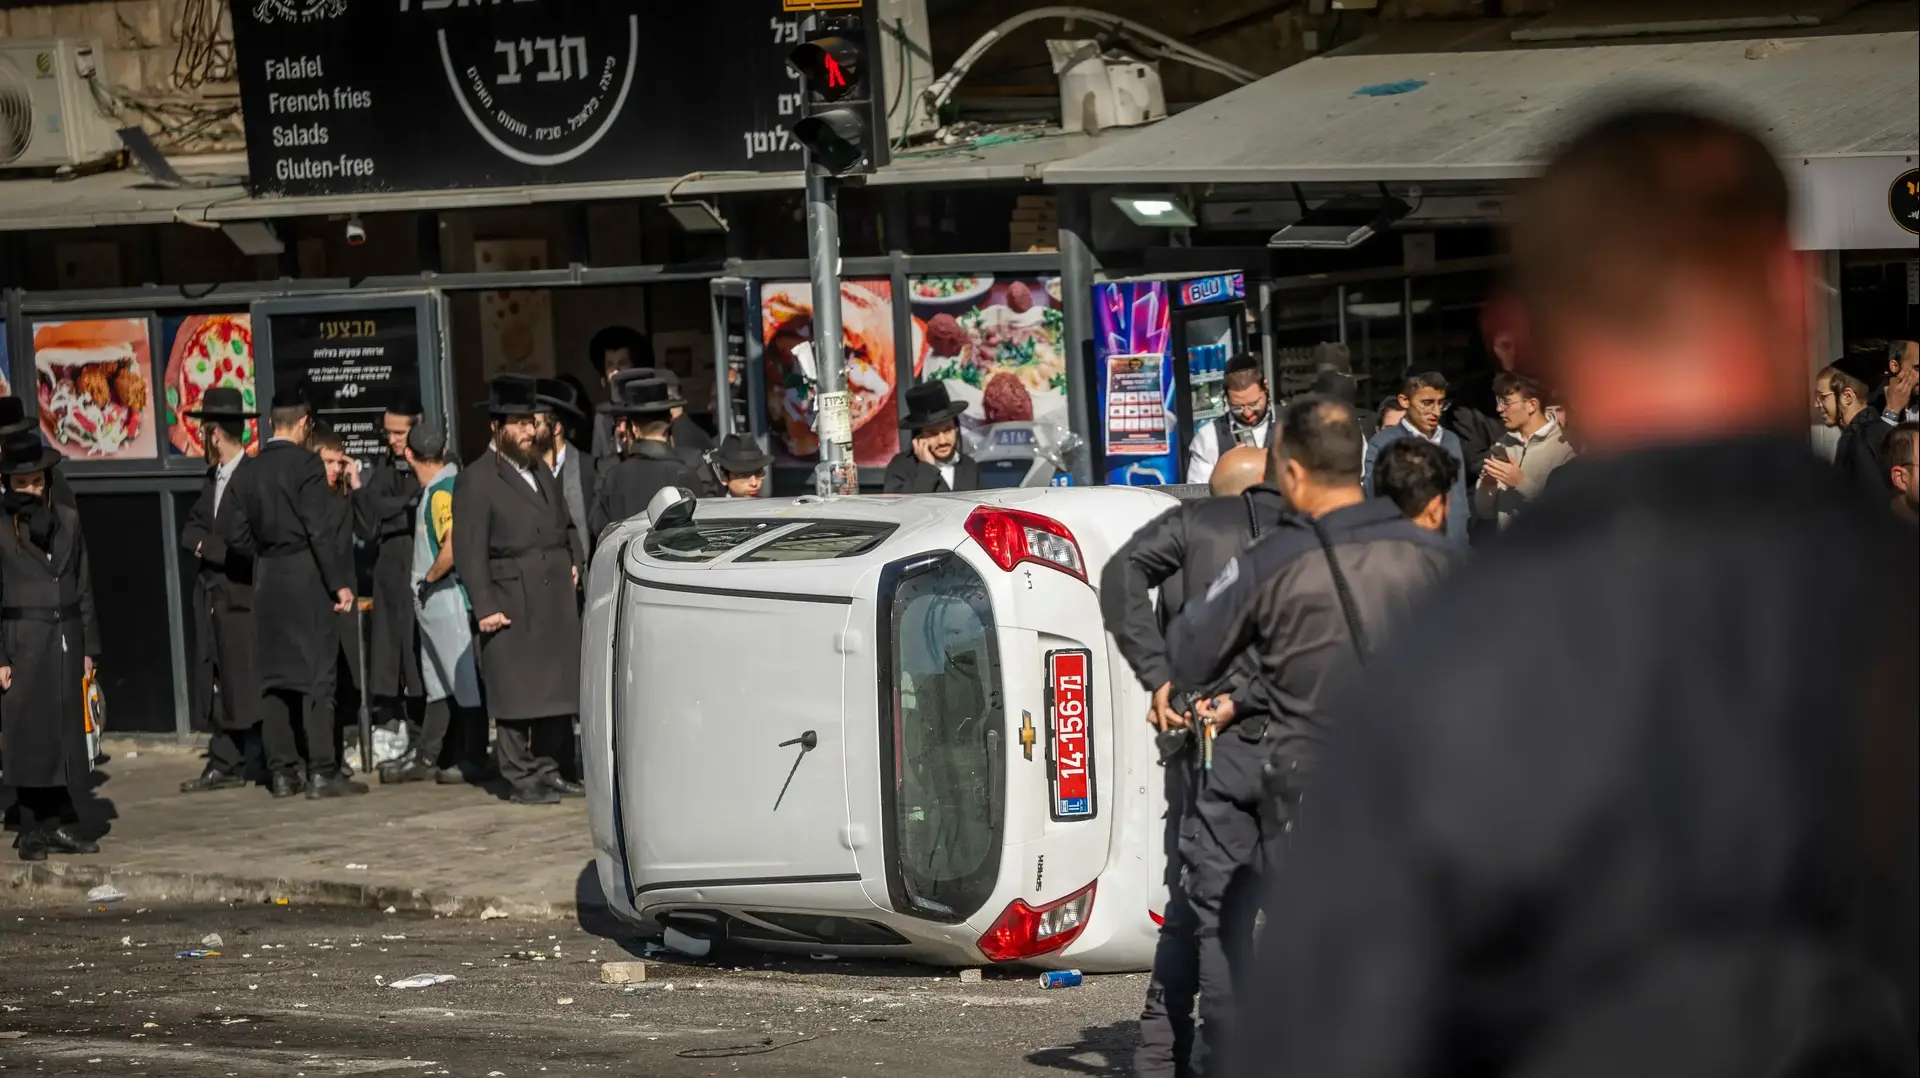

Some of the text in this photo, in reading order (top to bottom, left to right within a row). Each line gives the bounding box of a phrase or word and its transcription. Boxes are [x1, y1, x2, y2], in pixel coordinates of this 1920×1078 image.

[265, 55, 323, 80] Falafel
[494, 35, 588, 84] חביב
[269, 86, 372, 114] French fries
[466, 55, 616, 140] פיצה פלאפל סביח חומוס מאפים
[272, 122, 329, 147] Salads
[276, 154, 375, 180] Gluten-free
[1191, 279, 1220, 301] BLU
[319, 320, 376, 340] מבצע!
[1068, 801, 1080, 811] IL
[1035, 854, 1044, 892] SPARK
